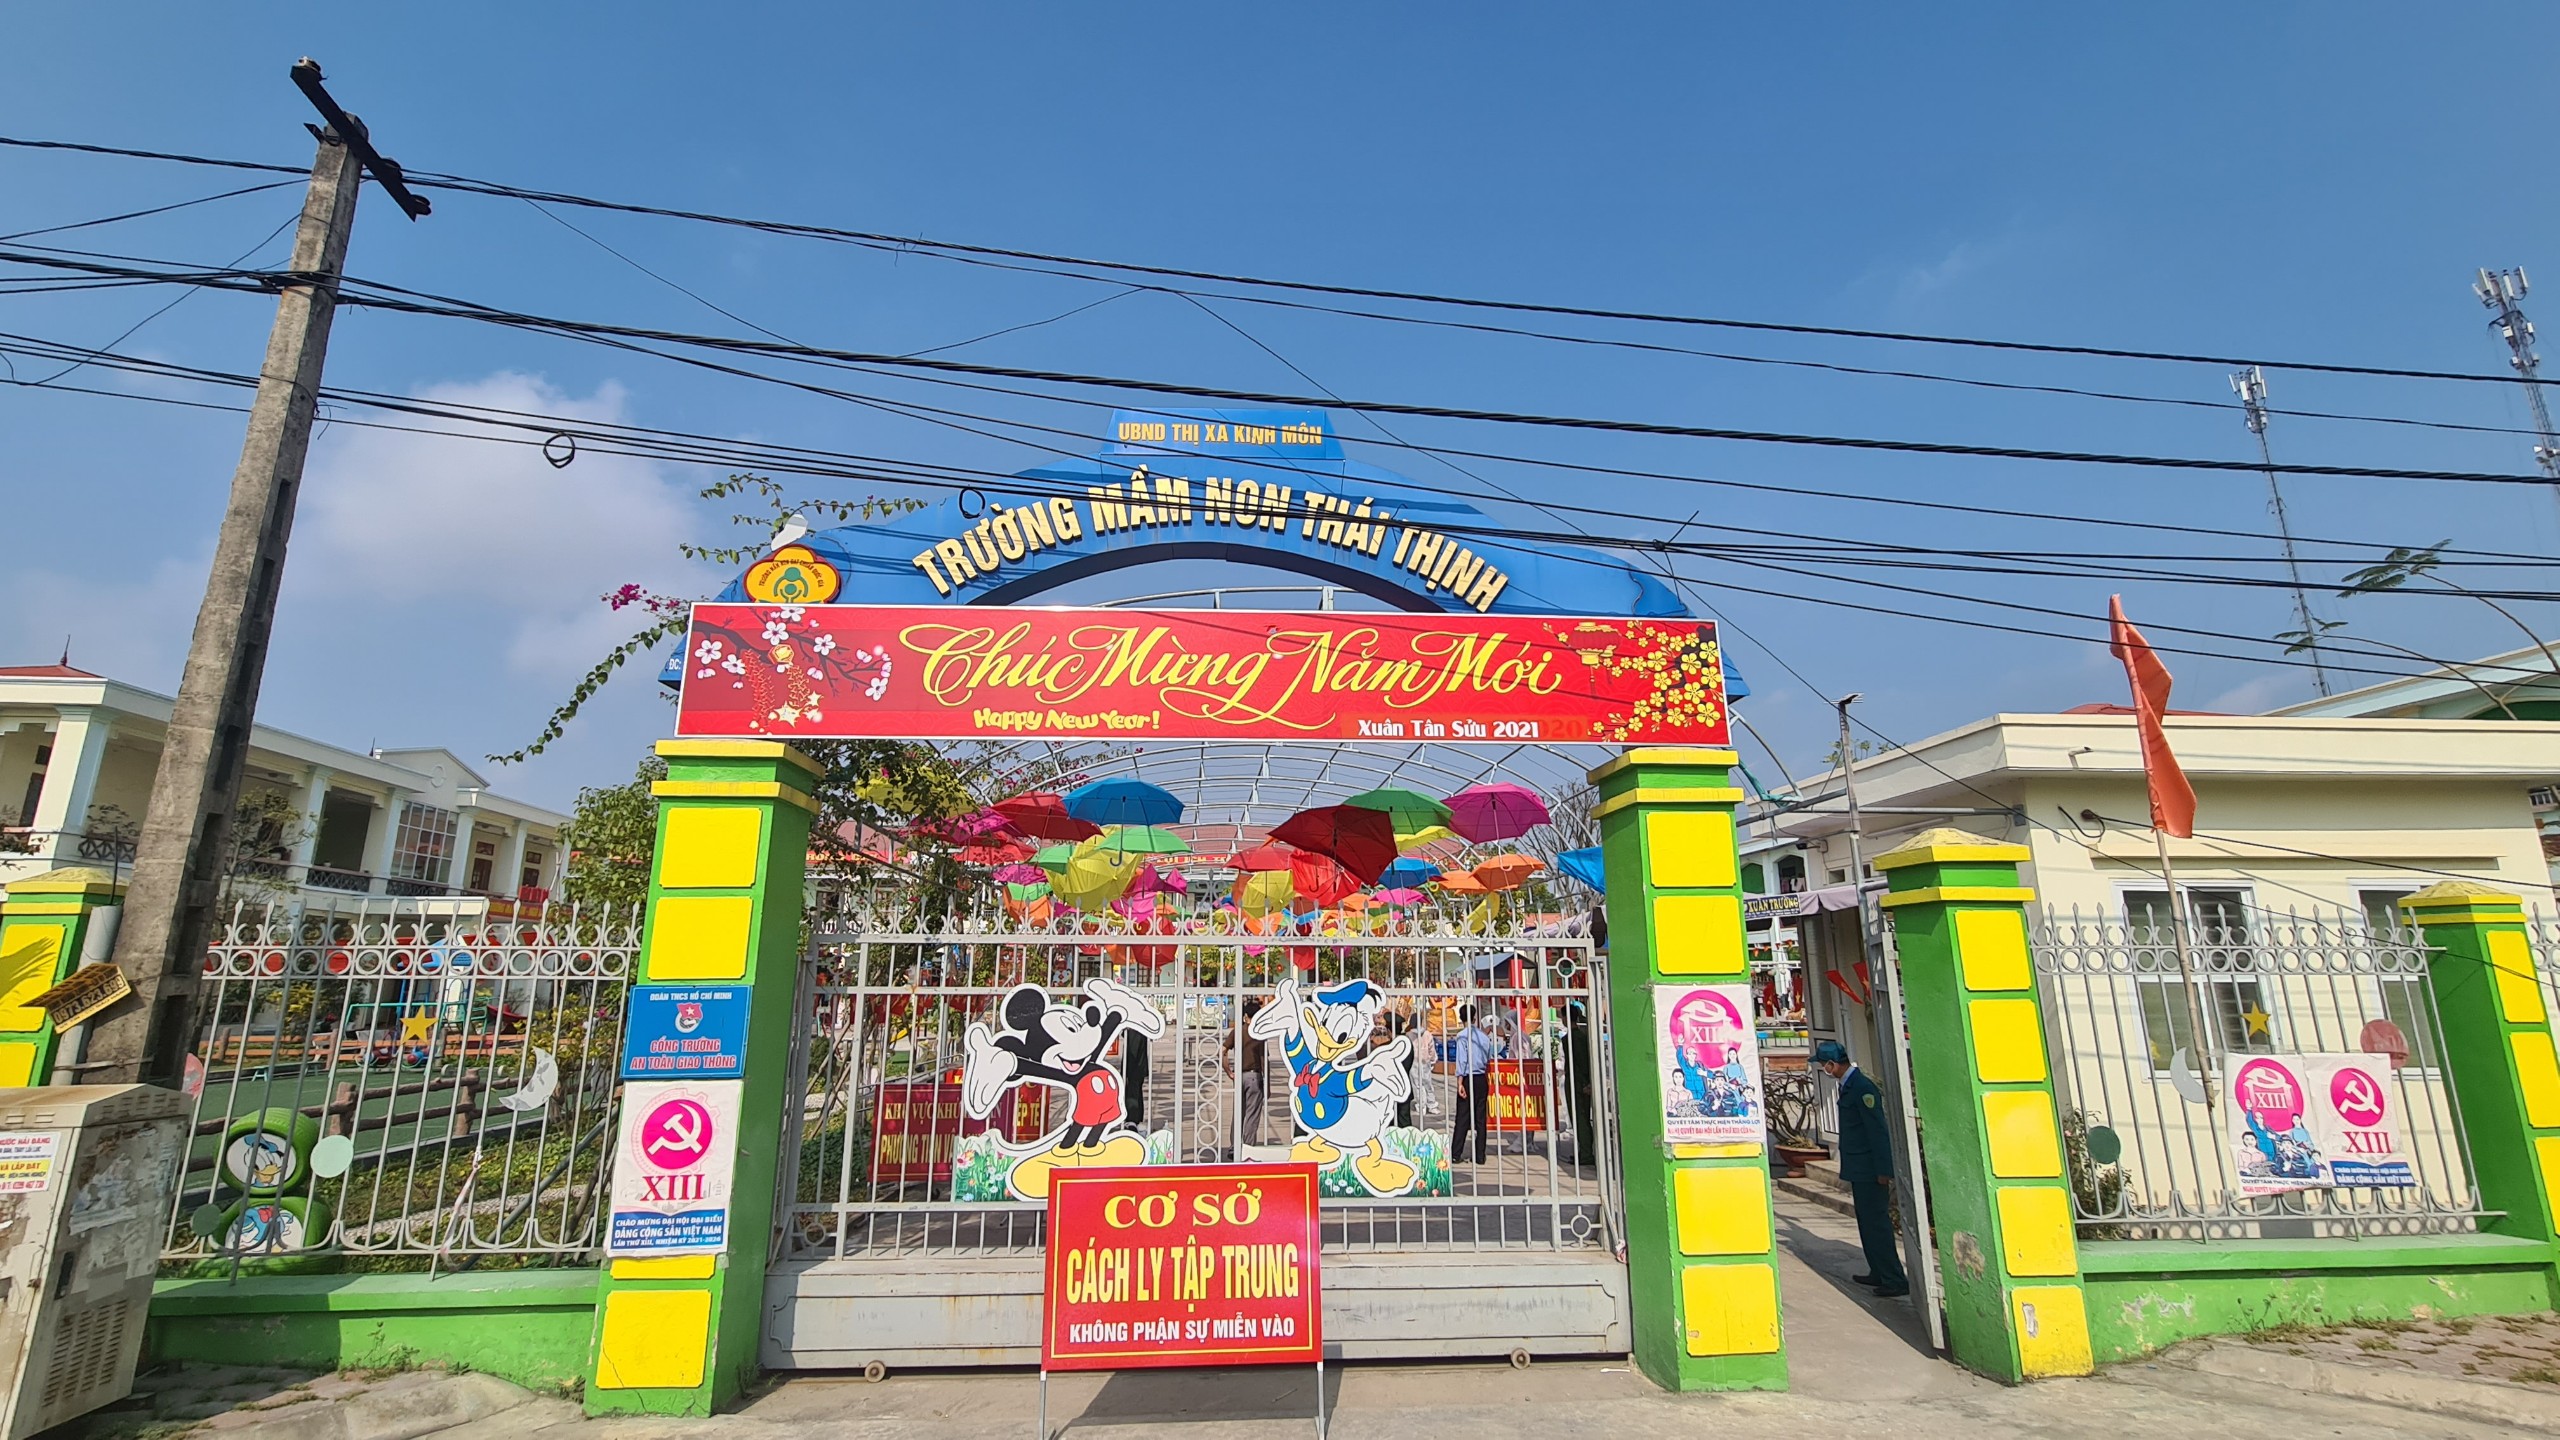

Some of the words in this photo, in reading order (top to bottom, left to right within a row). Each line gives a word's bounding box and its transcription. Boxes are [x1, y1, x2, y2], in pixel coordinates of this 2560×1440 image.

[1118, 422, 1166, 442] UBND
[1171, 423, 1200, 447] THỊ
[1234, 424, 1277, 446] KINH
[1281, 421, 1323, 445] MÔN
[911, 497, 1083, 596] TRƯỜNG
[1087, 464, 1193, 533] MẦM
[1203, 476, 1292, 531] NON
[1301, 490, 1391, 556] THÁI
[1392, 518, 1510, 614] THỊNH
[668, 658, 682, 670] ĐC:
[898, 621, 1087, 707] Chúc
[1036, 624, 1272, 725] Mừng
[1262, 627, 1438, 725] Năm
[1384, 631, 1563, 708] Mới
[972, 706, 1044, 732] Happy
[1044, 707, 1099, 731] New
[1357, 717, 1404, 738] Xuân
[1410, 717, 1446, 738] Tân
[1451, 715, 1487, 738] Sửu
[1492, 720, 1540, 739] 2021
[680, 1036, 722, 1053] TRƯỜNG
[629, 1056, 647, 1071] AN
[647, 1054, 676, 1070] TOÀN
[675, 1055, 702, 1070] GIAO
[702, 1053, 738, 1069] THÔNG
[911, 1100, 933, 1125] VỰC
[2254, 1091, 2289, 1109] XIII
[920, 1133, 943, 1165] TIN
[942, 1126, 957, 1170] VẬ
[2342, 1131, 2393, 1154] XIII
[639, 1173, 706, 1202] XIII
[1103, 1190, 1179, 1229] CƠ
[1192, 1181, 1263, 1228] SỞ
[614, 1226, 639, 1239] ĐẢNG
[639, 1226, 663, 1239] CỘNG
[663, 1225, 682, 1237] SẢN
[682, 1224, 701, 1237] VIỆT
[702, 1224, 722, 1235] NAM
[615, 1218, 638, 1227] CHÀO
[636, 1217, 661, 1226] MỪNG
[661, 1217, 675, 1226] ĐẠI
[675, 1216, 690, 1226] HỘI
[1065, 1236, 1131, 1305] CÁCH
[1136, 1246, 1165, 1301] LY
[1170, 1234, 1216, 1313] TẬP
[1221, 1242, 1300, 1300] TRUNG
[1069, 1320, 1129, 1343] KHÔNG
[1133, 1316, 1180, 1345] PHẬN
[1184, 1317, 1211, 1345] SỰ
[1212, 1311, 1257, 1340] MIỄN
[1261, 1313, 1296, 1338] VÀO
